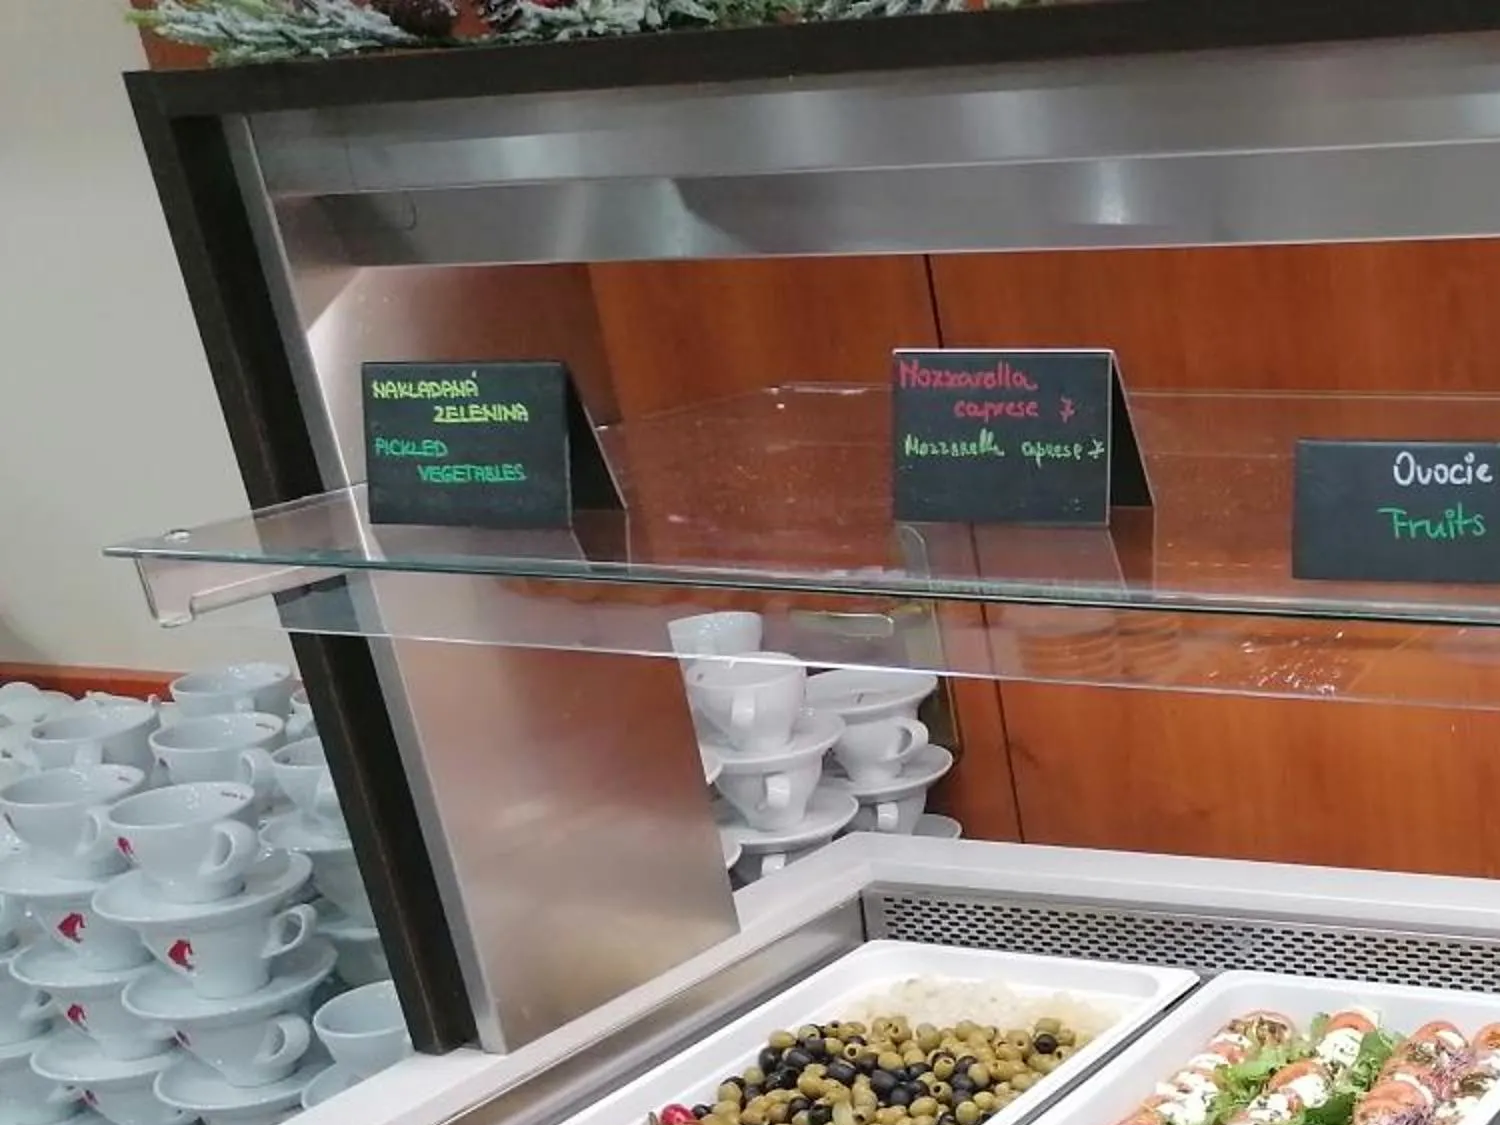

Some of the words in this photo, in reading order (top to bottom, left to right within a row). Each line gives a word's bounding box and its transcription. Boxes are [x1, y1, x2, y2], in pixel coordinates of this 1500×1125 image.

[374, 438, 448, 457] PICKLED
[418, 463, 527, 482] VEGETABLES
[1393, 451, 1494, 487] Ovocie
[1377, 502, 1487, 541] Fruits
